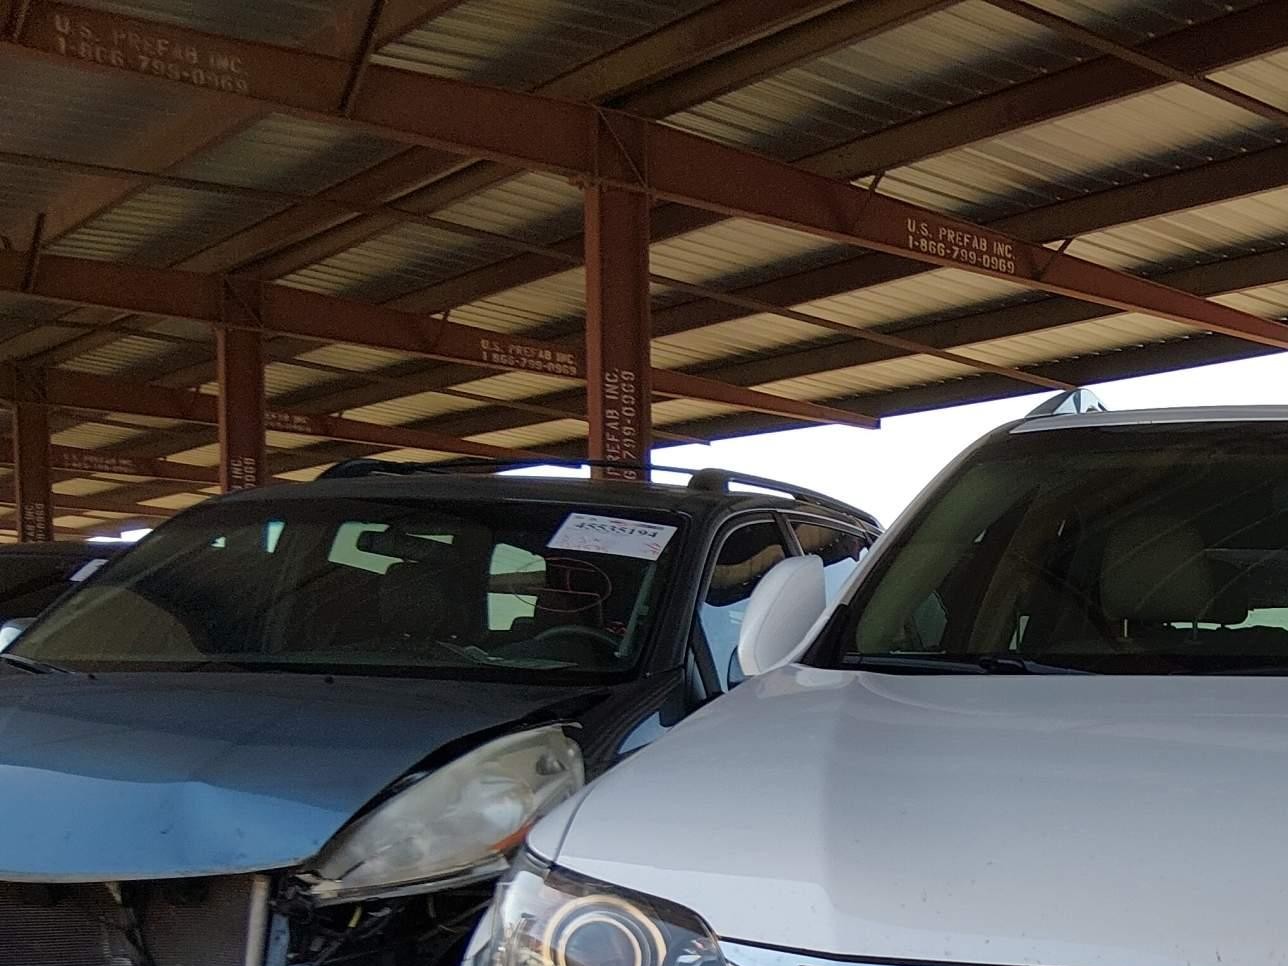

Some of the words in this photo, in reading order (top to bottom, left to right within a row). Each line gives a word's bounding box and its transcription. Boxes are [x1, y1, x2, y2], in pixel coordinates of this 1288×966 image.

[906, 217, 933, 239] U.S.
[939, 227, 988, 252] PREFAB
[993, 241, 1016, 260] INC.
[907, 235, 1015, 274] 1-866-799-0969
[604, 368, 620, 400] INC.
